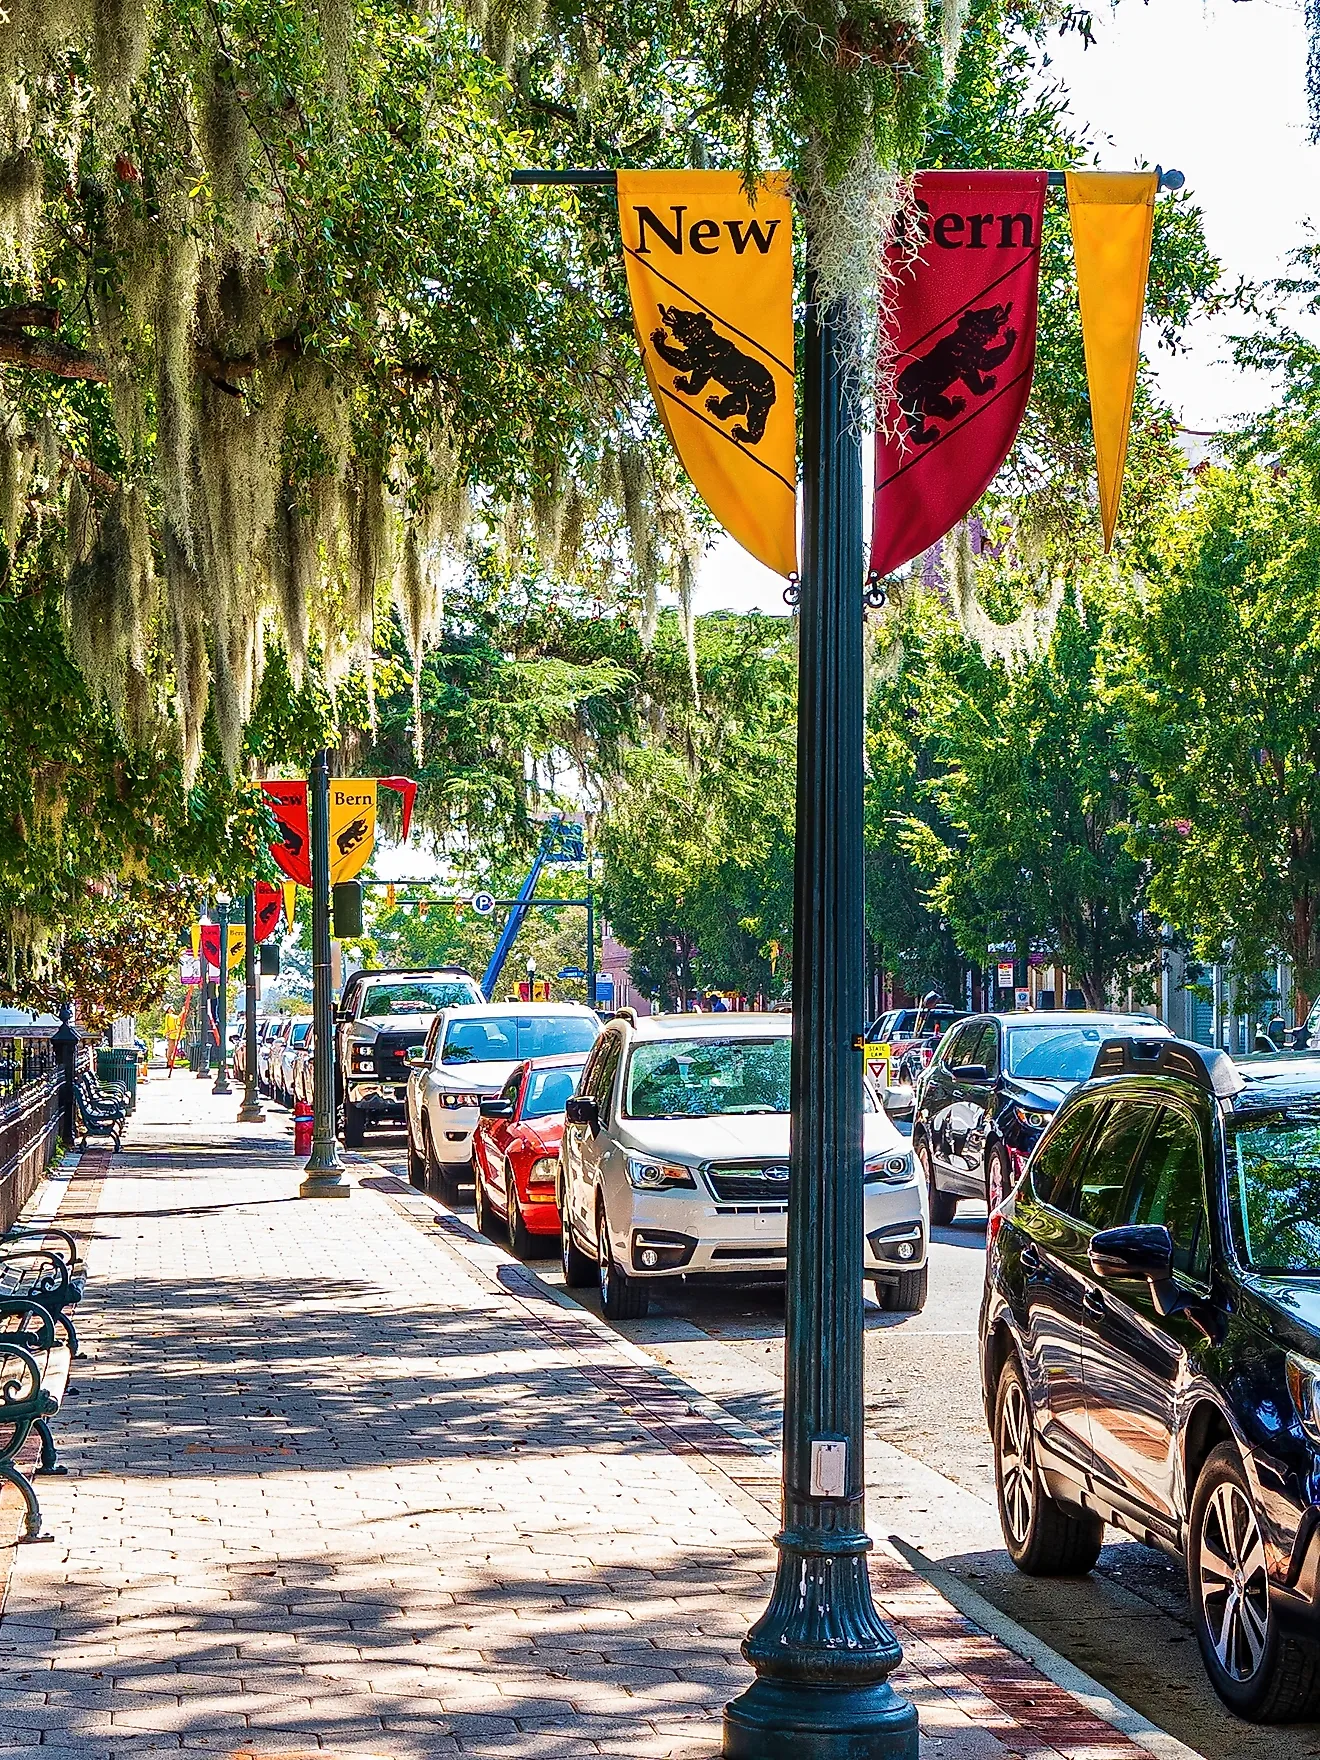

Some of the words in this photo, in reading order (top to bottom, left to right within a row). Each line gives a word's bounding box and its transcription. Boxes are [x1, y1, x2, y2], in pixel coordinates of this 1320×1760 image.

[632, 206, 782, 255] New
[334, 791, 372, 805] Bern
[480, 897, 489, 909] P
